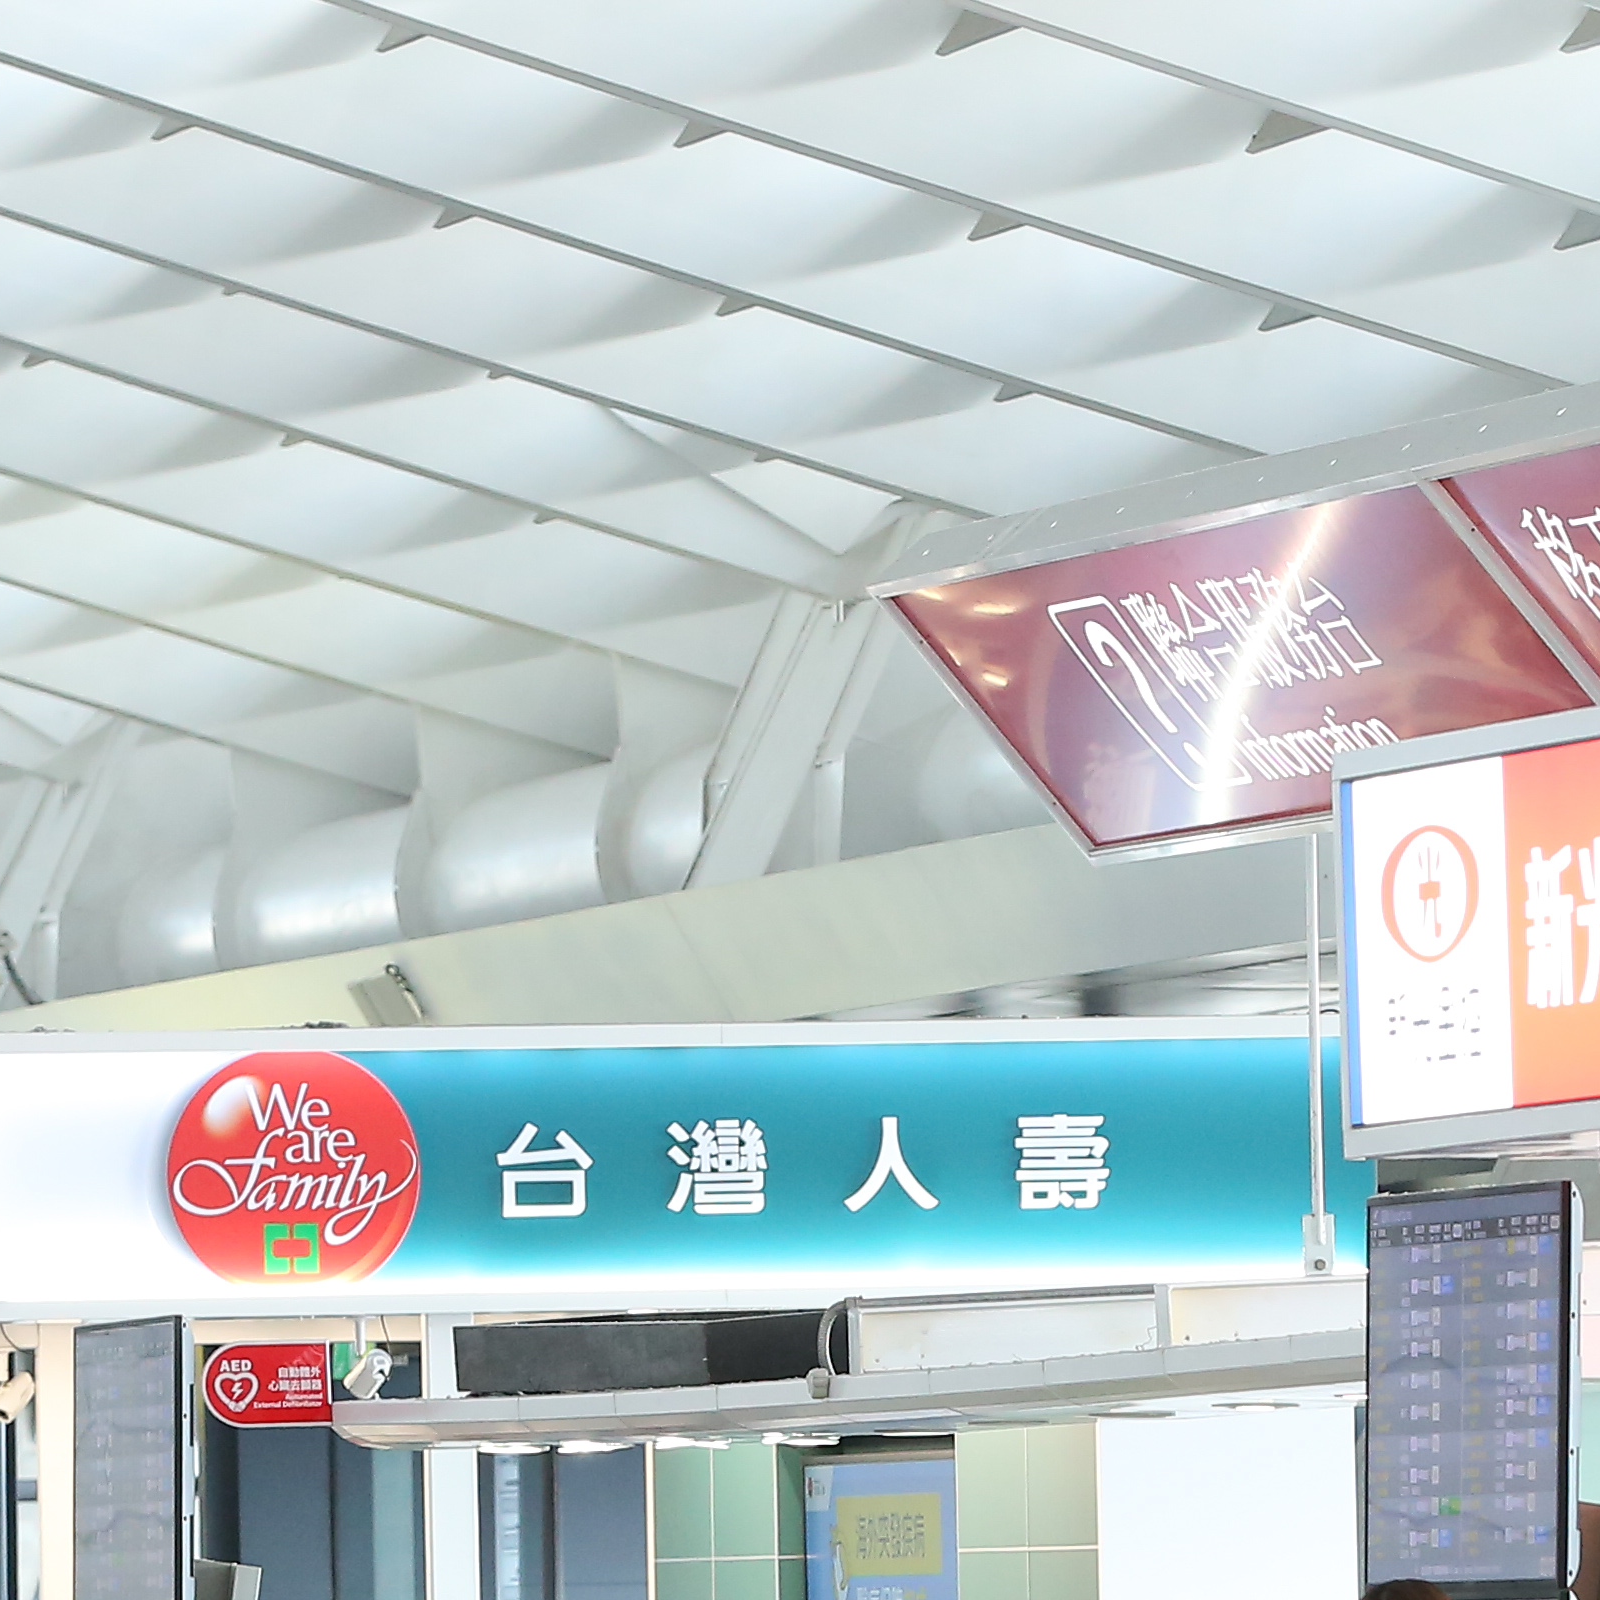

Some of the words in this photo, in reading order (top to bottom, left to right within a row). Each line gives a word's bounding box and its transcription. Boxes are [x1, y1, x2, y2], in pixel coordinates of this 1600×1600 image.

[245, 1081, 332, 1132] We
[283, 1127, 358, 1164] are
[494, 1112, 1112, 1221] 台灣人壽
[219, 1359, 252, 1372] AED
